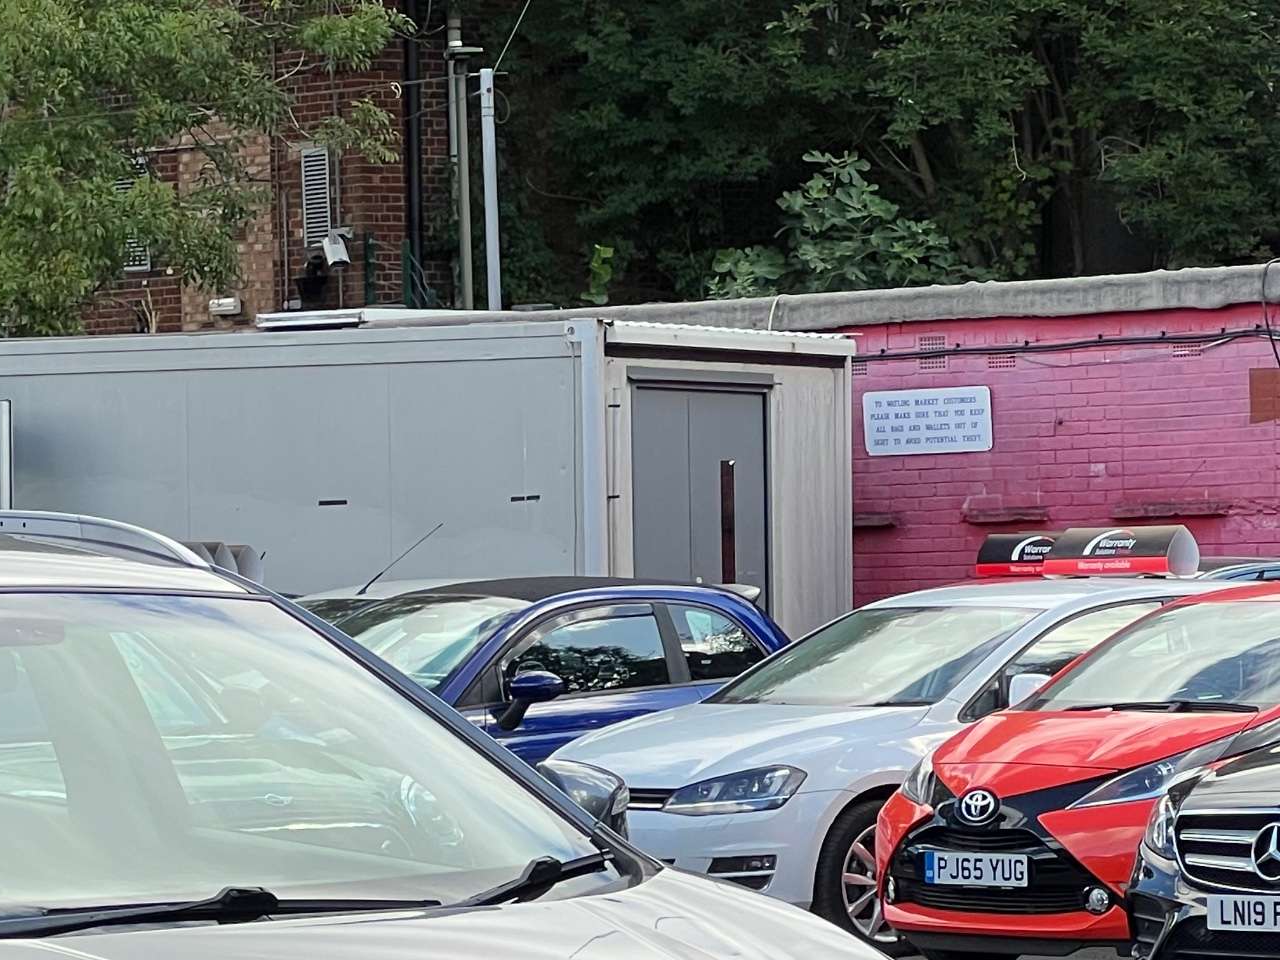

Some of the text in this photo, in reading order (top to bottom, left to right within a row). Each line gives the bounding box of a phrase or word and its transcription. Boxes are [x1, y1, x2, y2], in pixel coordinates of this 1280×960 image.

[915, 398, 938, 406] MARKET
[870, 412, 890, 421] PLEASE
[894, 411, 911, 419] MAKE
[969, 408, 984, 416] KEEP
[875, 425, 886, 433] ALL
[908, 424, 921, 432] AND
[1099, 538, 1136, 550] Warranty
[937, 856, 1025, 882] PJ65 YUG
[1220, 899, 1265, 926] LN19
